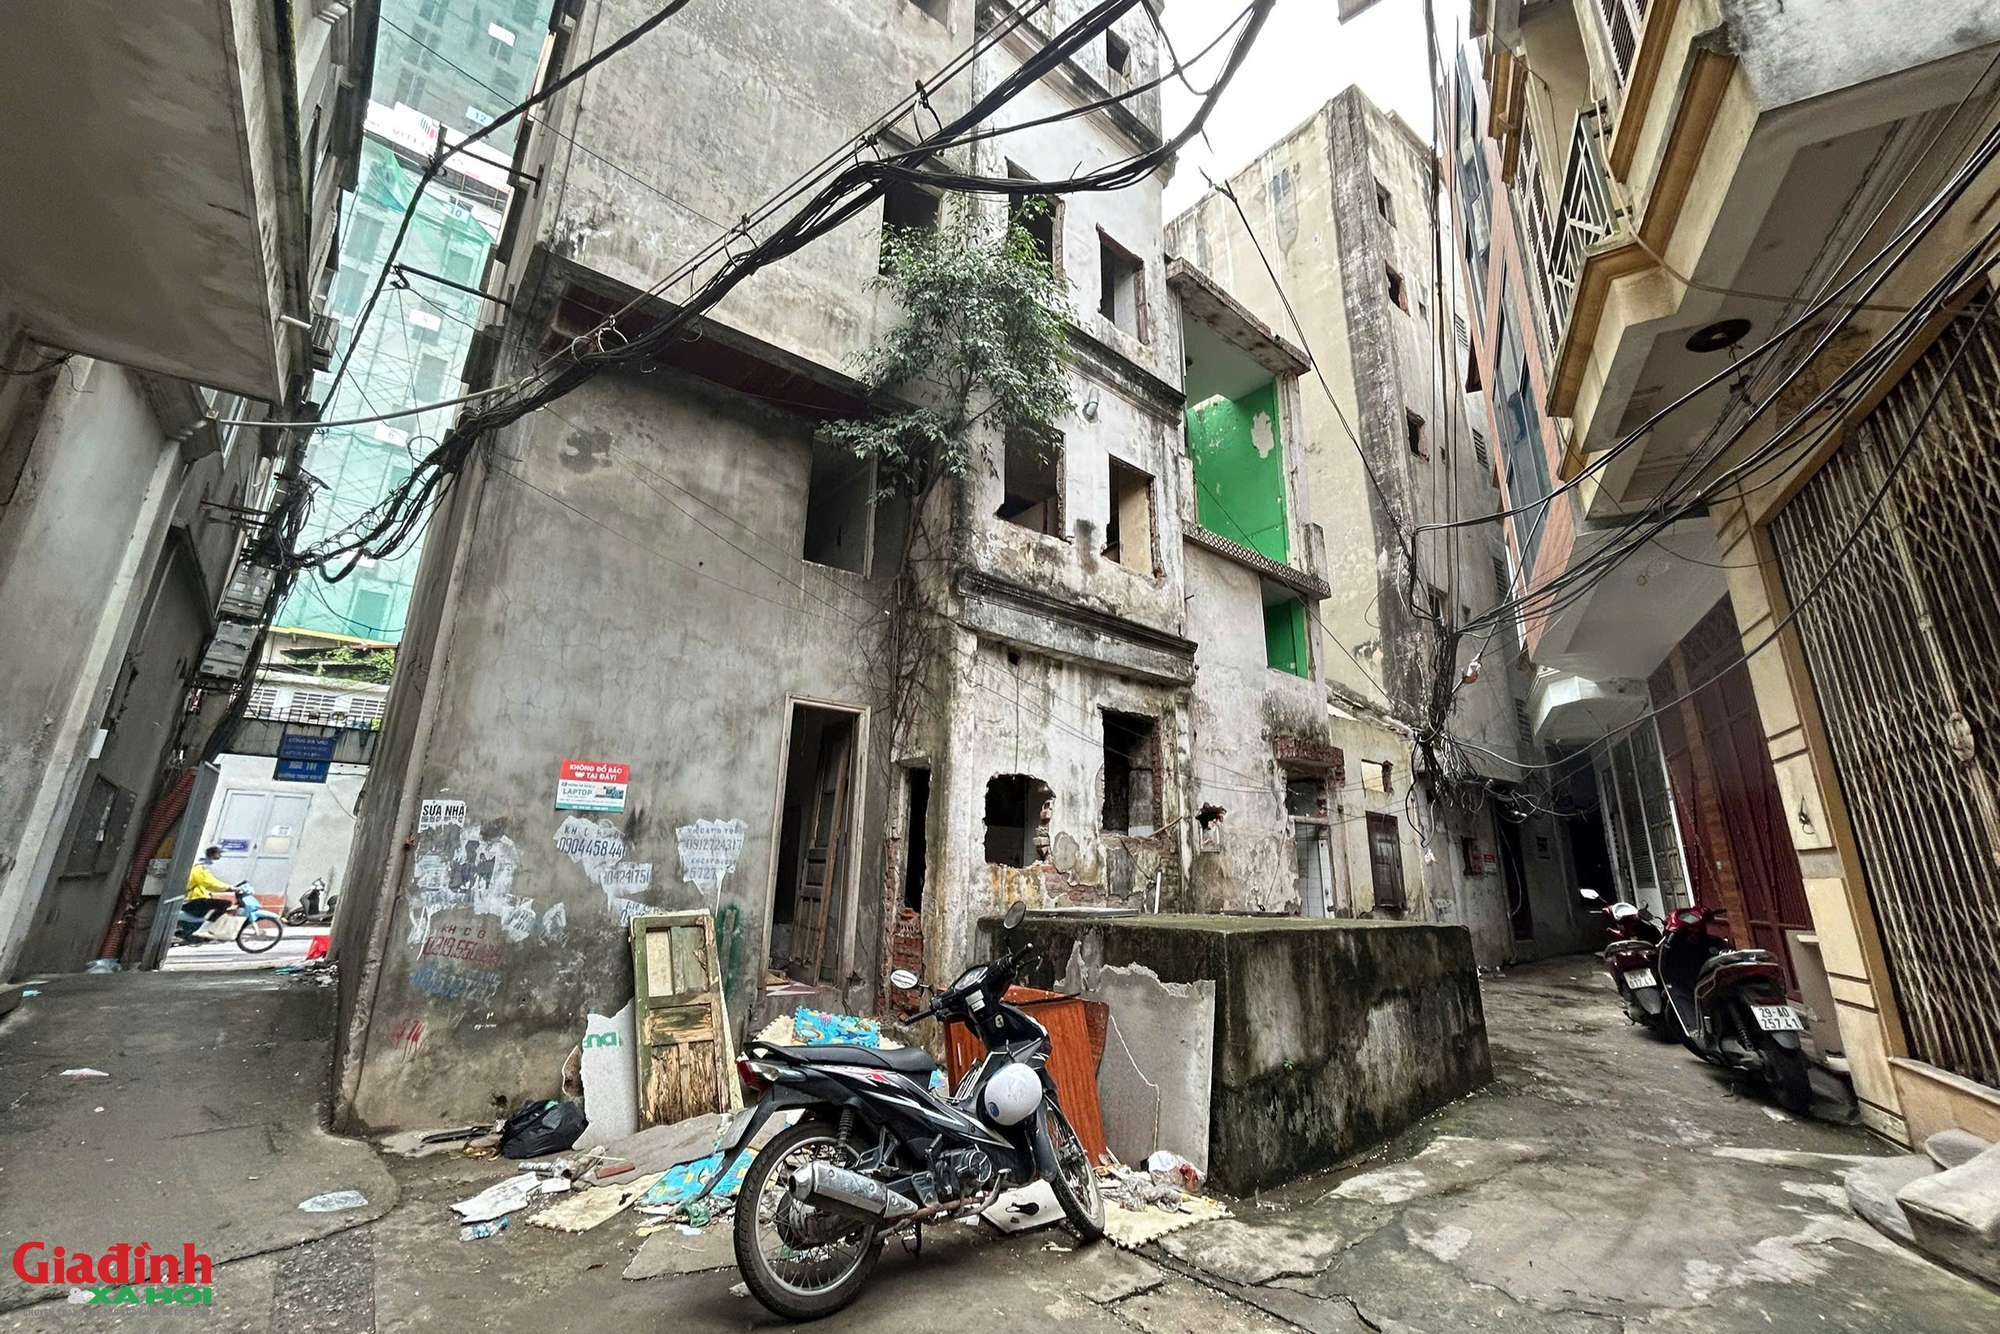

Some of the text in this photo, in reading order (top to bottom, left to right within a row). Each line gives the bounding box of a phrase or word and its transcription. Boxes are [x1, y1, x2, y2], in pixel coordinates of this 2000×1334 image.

[569, 763, 595, 772] KHÔNG
[586, 772, 599, 781] TẠI
[562, 788, 593, 796] LAPTOP
